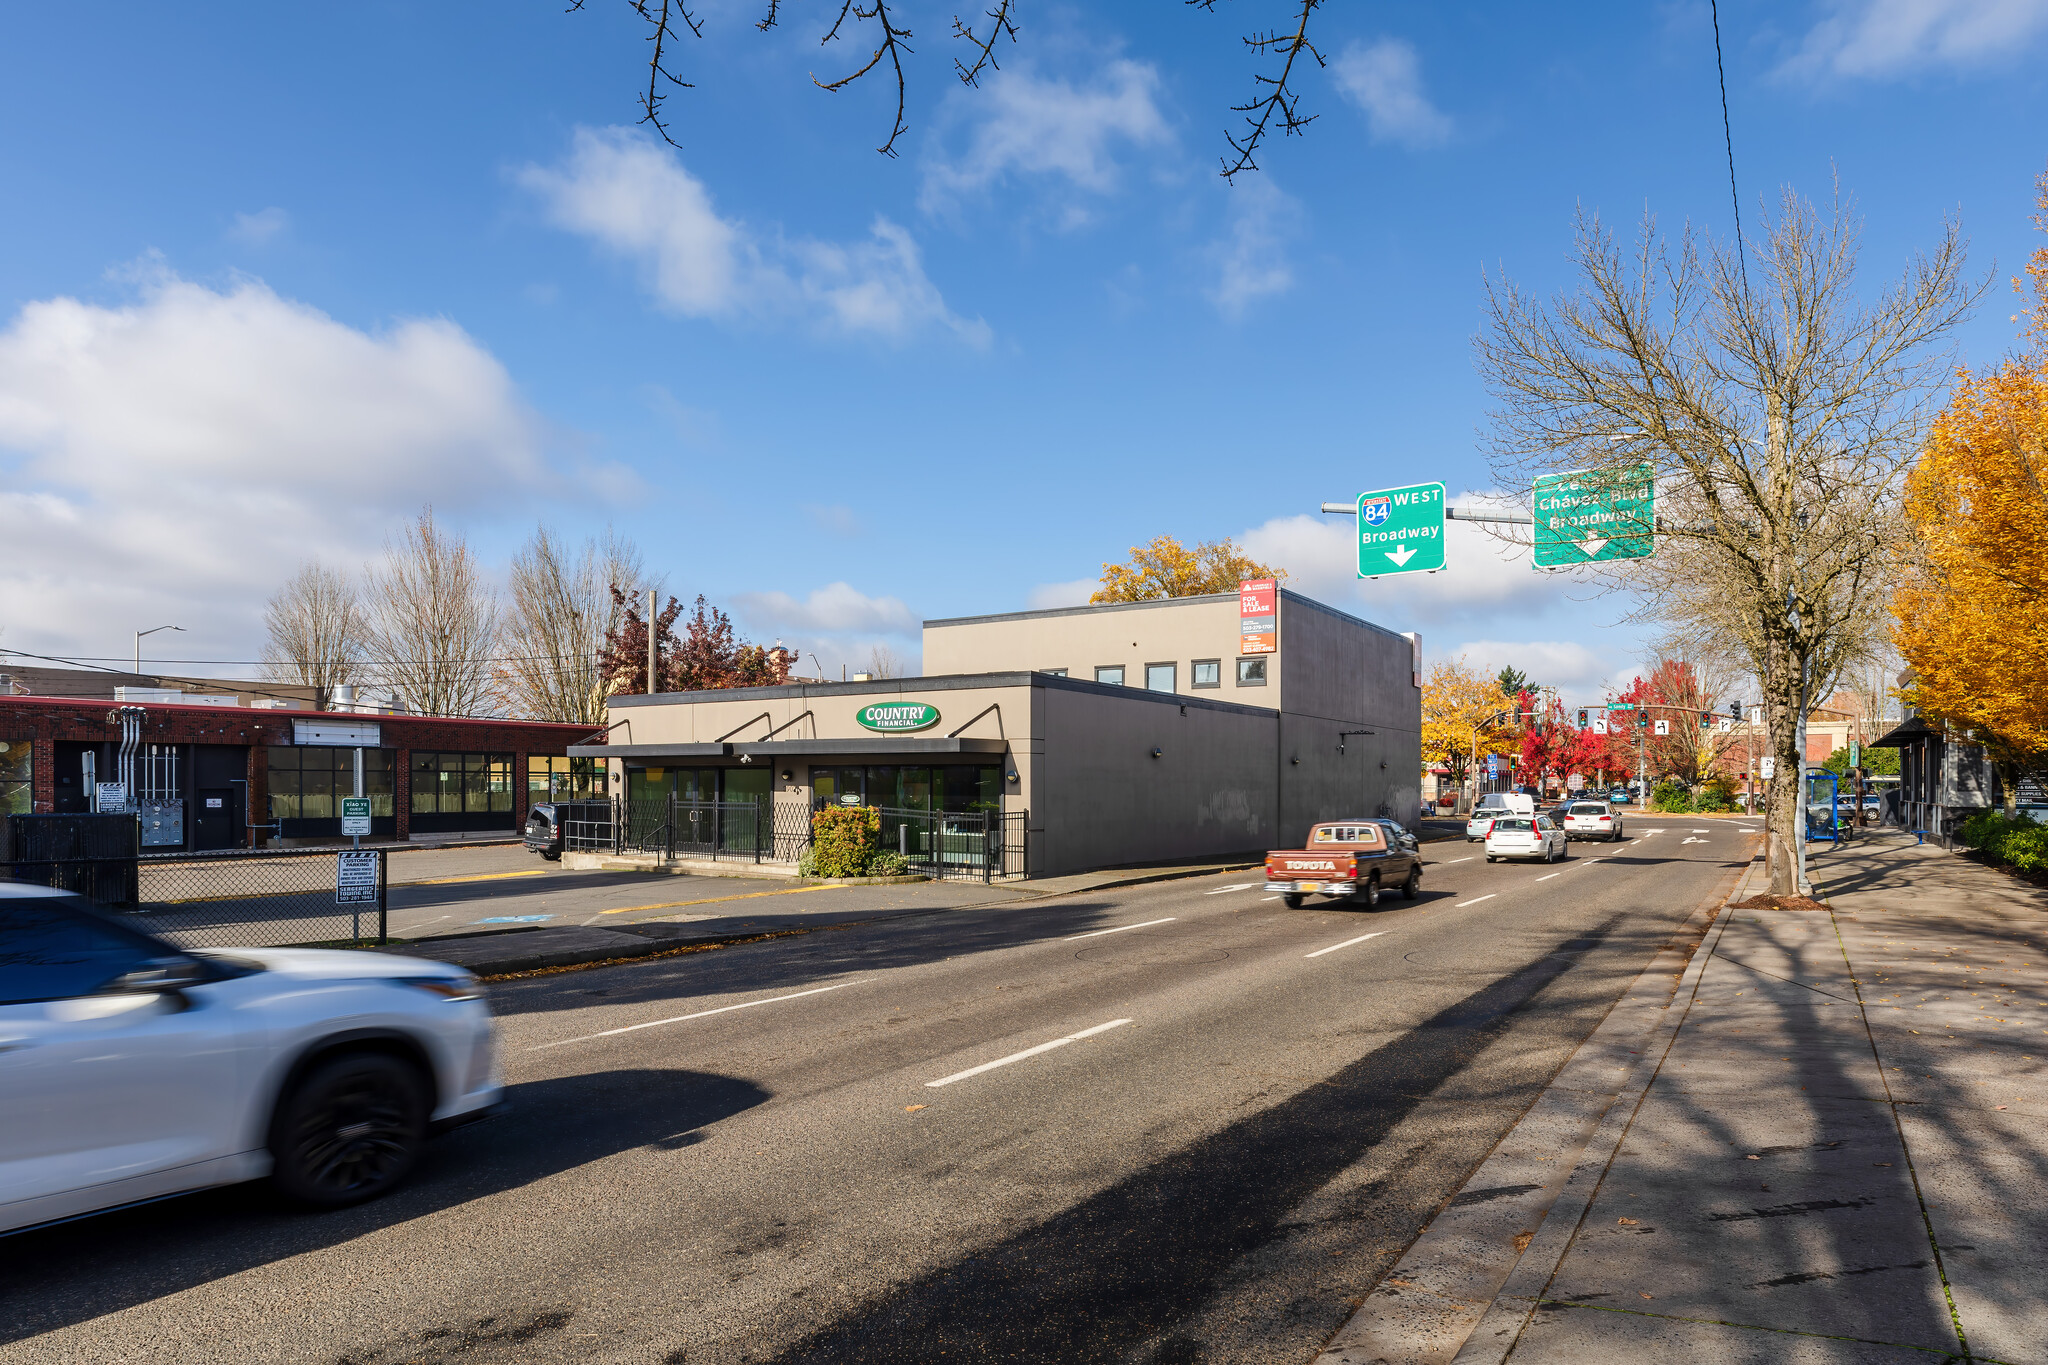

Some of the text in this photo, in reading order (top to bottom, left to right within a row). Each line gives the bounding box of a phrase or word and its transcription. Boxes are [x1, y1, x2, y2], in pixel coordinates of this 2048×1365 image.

[1393, 489, 1440, 506] WEST
[1365, 503, 1388, 521] 84
[1550, 509, 1636, 529] Broadway
[1362, 525, 1439, 544] Broadway
[866, 706, 926, 720] COUNTRY
[1284, 861, 1336, 870] TOYOTA
